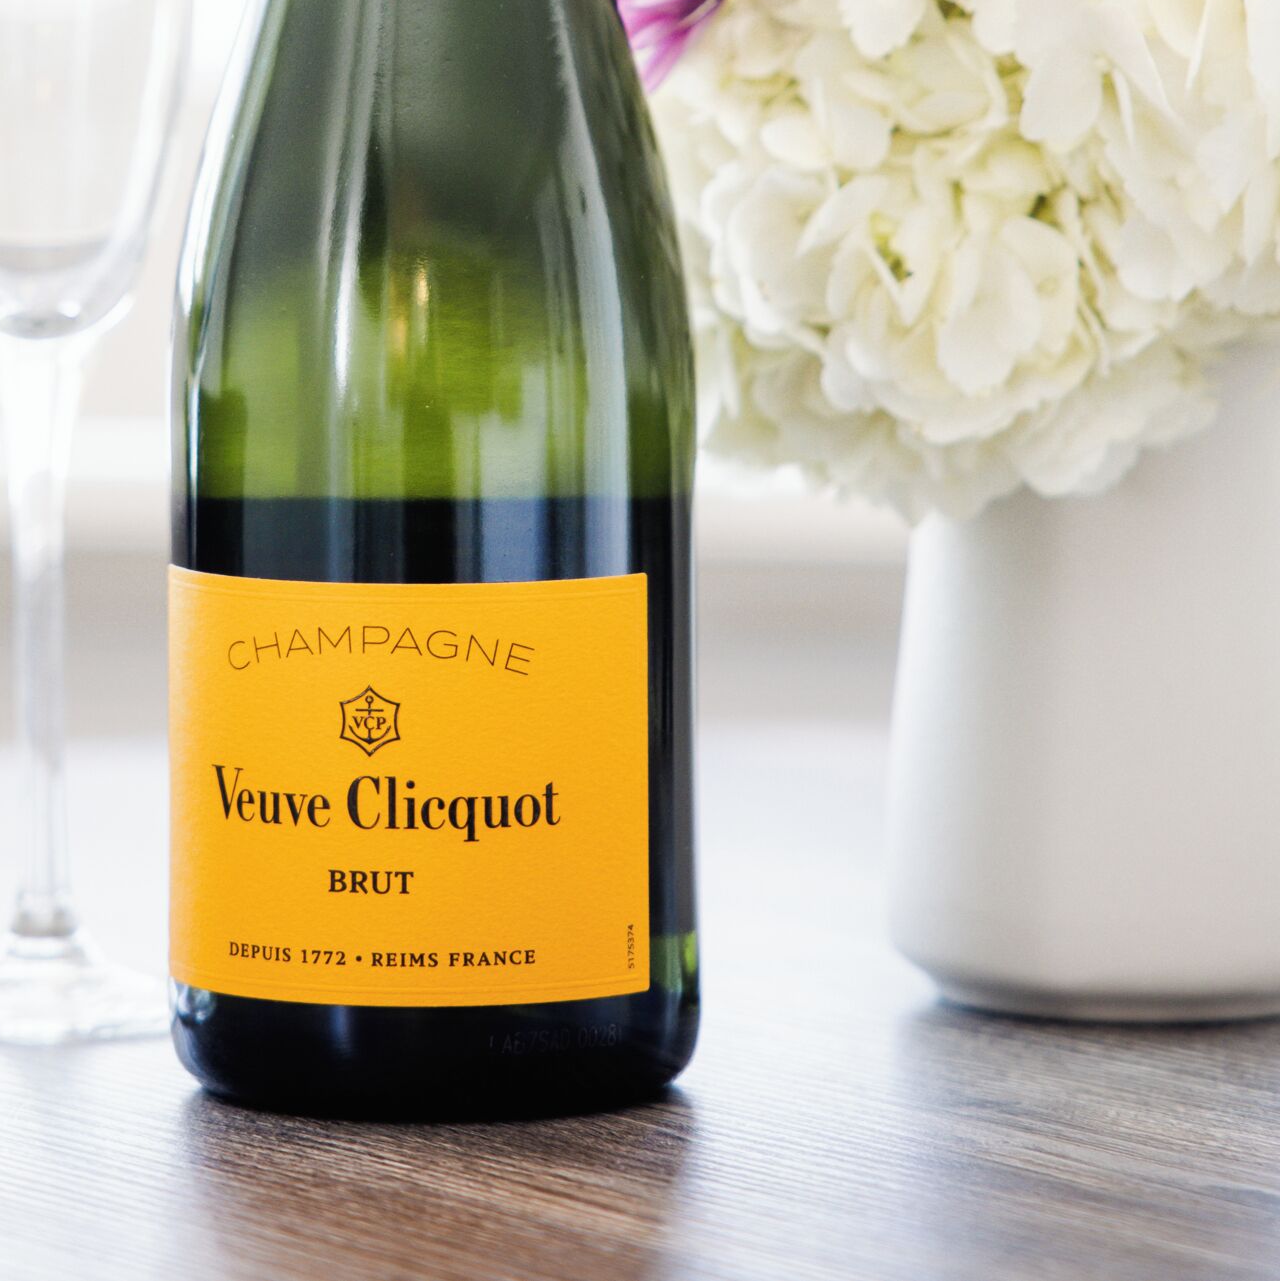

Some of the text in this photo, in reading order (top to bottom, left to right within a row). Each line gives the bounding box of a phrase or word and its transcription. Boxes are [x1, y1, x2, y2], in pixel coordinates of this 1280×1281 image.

[227, 625, 536, 676] CHAMPAGNE
[352, 715, 387, 730] VCP
[211, 763, 562, 843] Veuve Clicquot
[327, 868, 415, 895] BRUT
[228, 940, 537, 969] DEPUIS 1772 REIMS FRANCE
